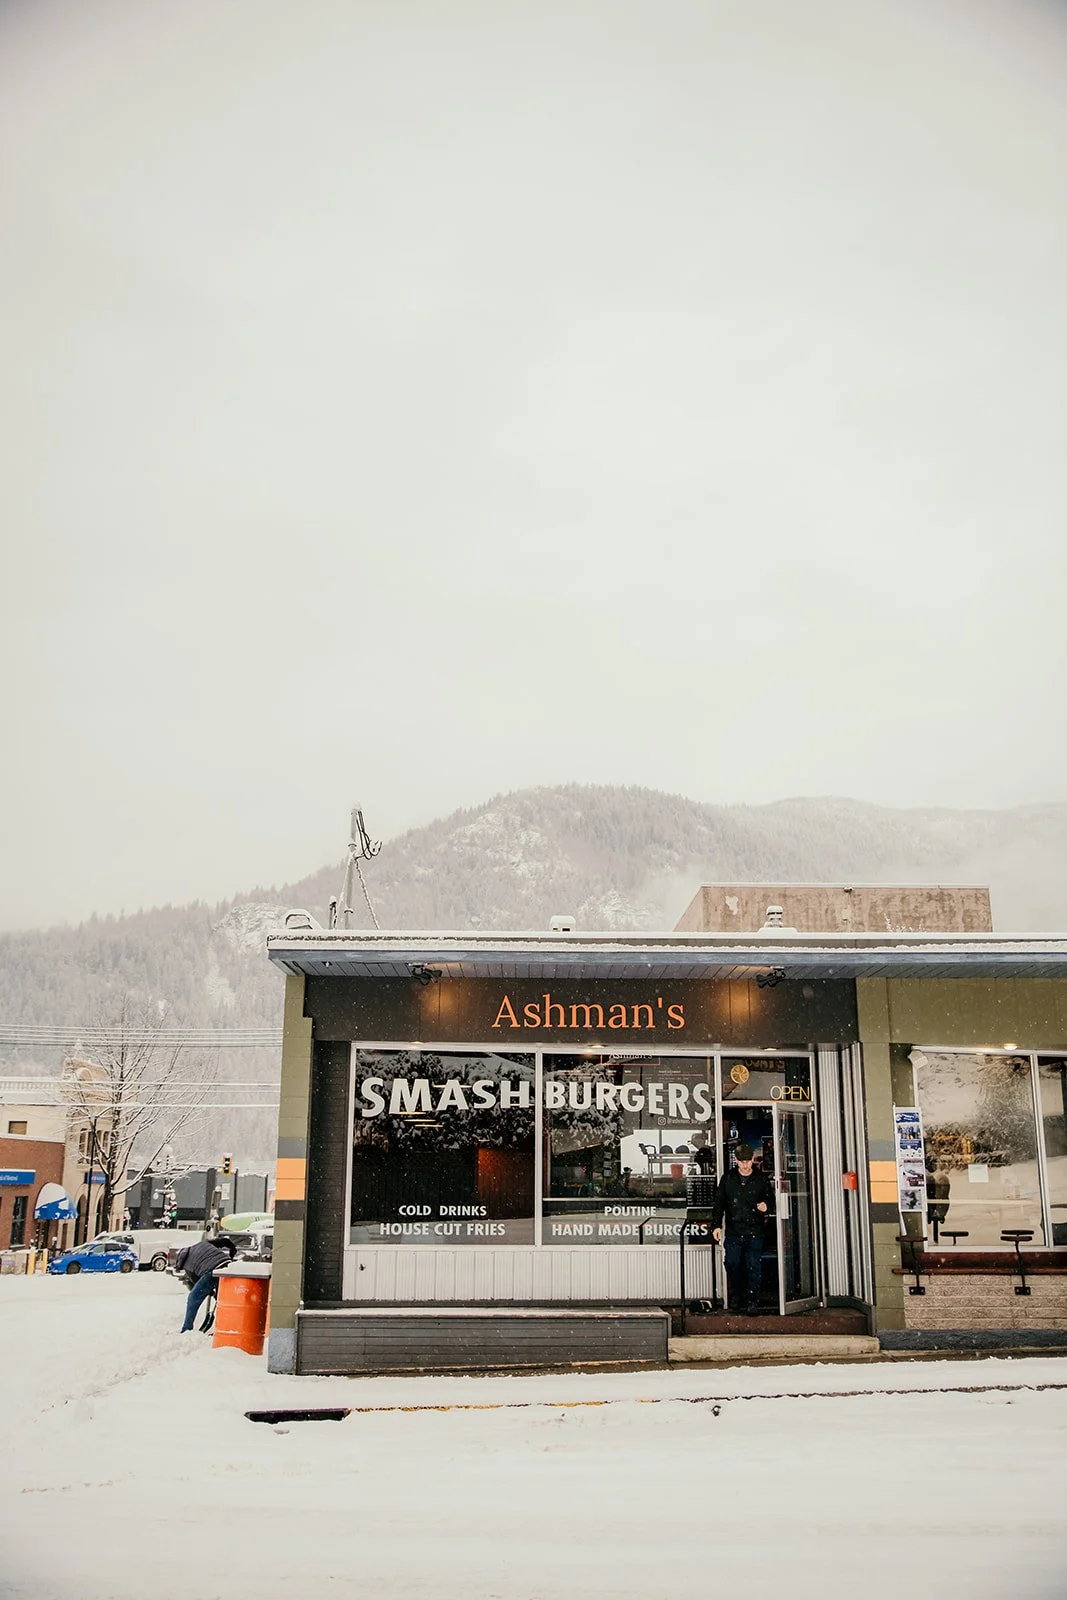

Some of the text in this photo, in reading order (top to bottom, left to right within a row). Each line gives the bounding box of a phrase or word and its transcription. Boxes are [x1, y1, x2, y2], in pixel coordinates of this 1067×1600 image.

[491, 993, 686, 1029] Ashman's
[360, 1077, 712, 1122] SMASH BURGERS
[770, 1085, 810, 1100] OPEN
[398, 1204, 488, 1216] COLD DRINKS
[604, 1205, 657, 1217] POUTINE
[379, 1222, 506, 1236] HOUSE CUT FRIES
[551, 1223, 708, 1236] HAND MADE BURGERS
